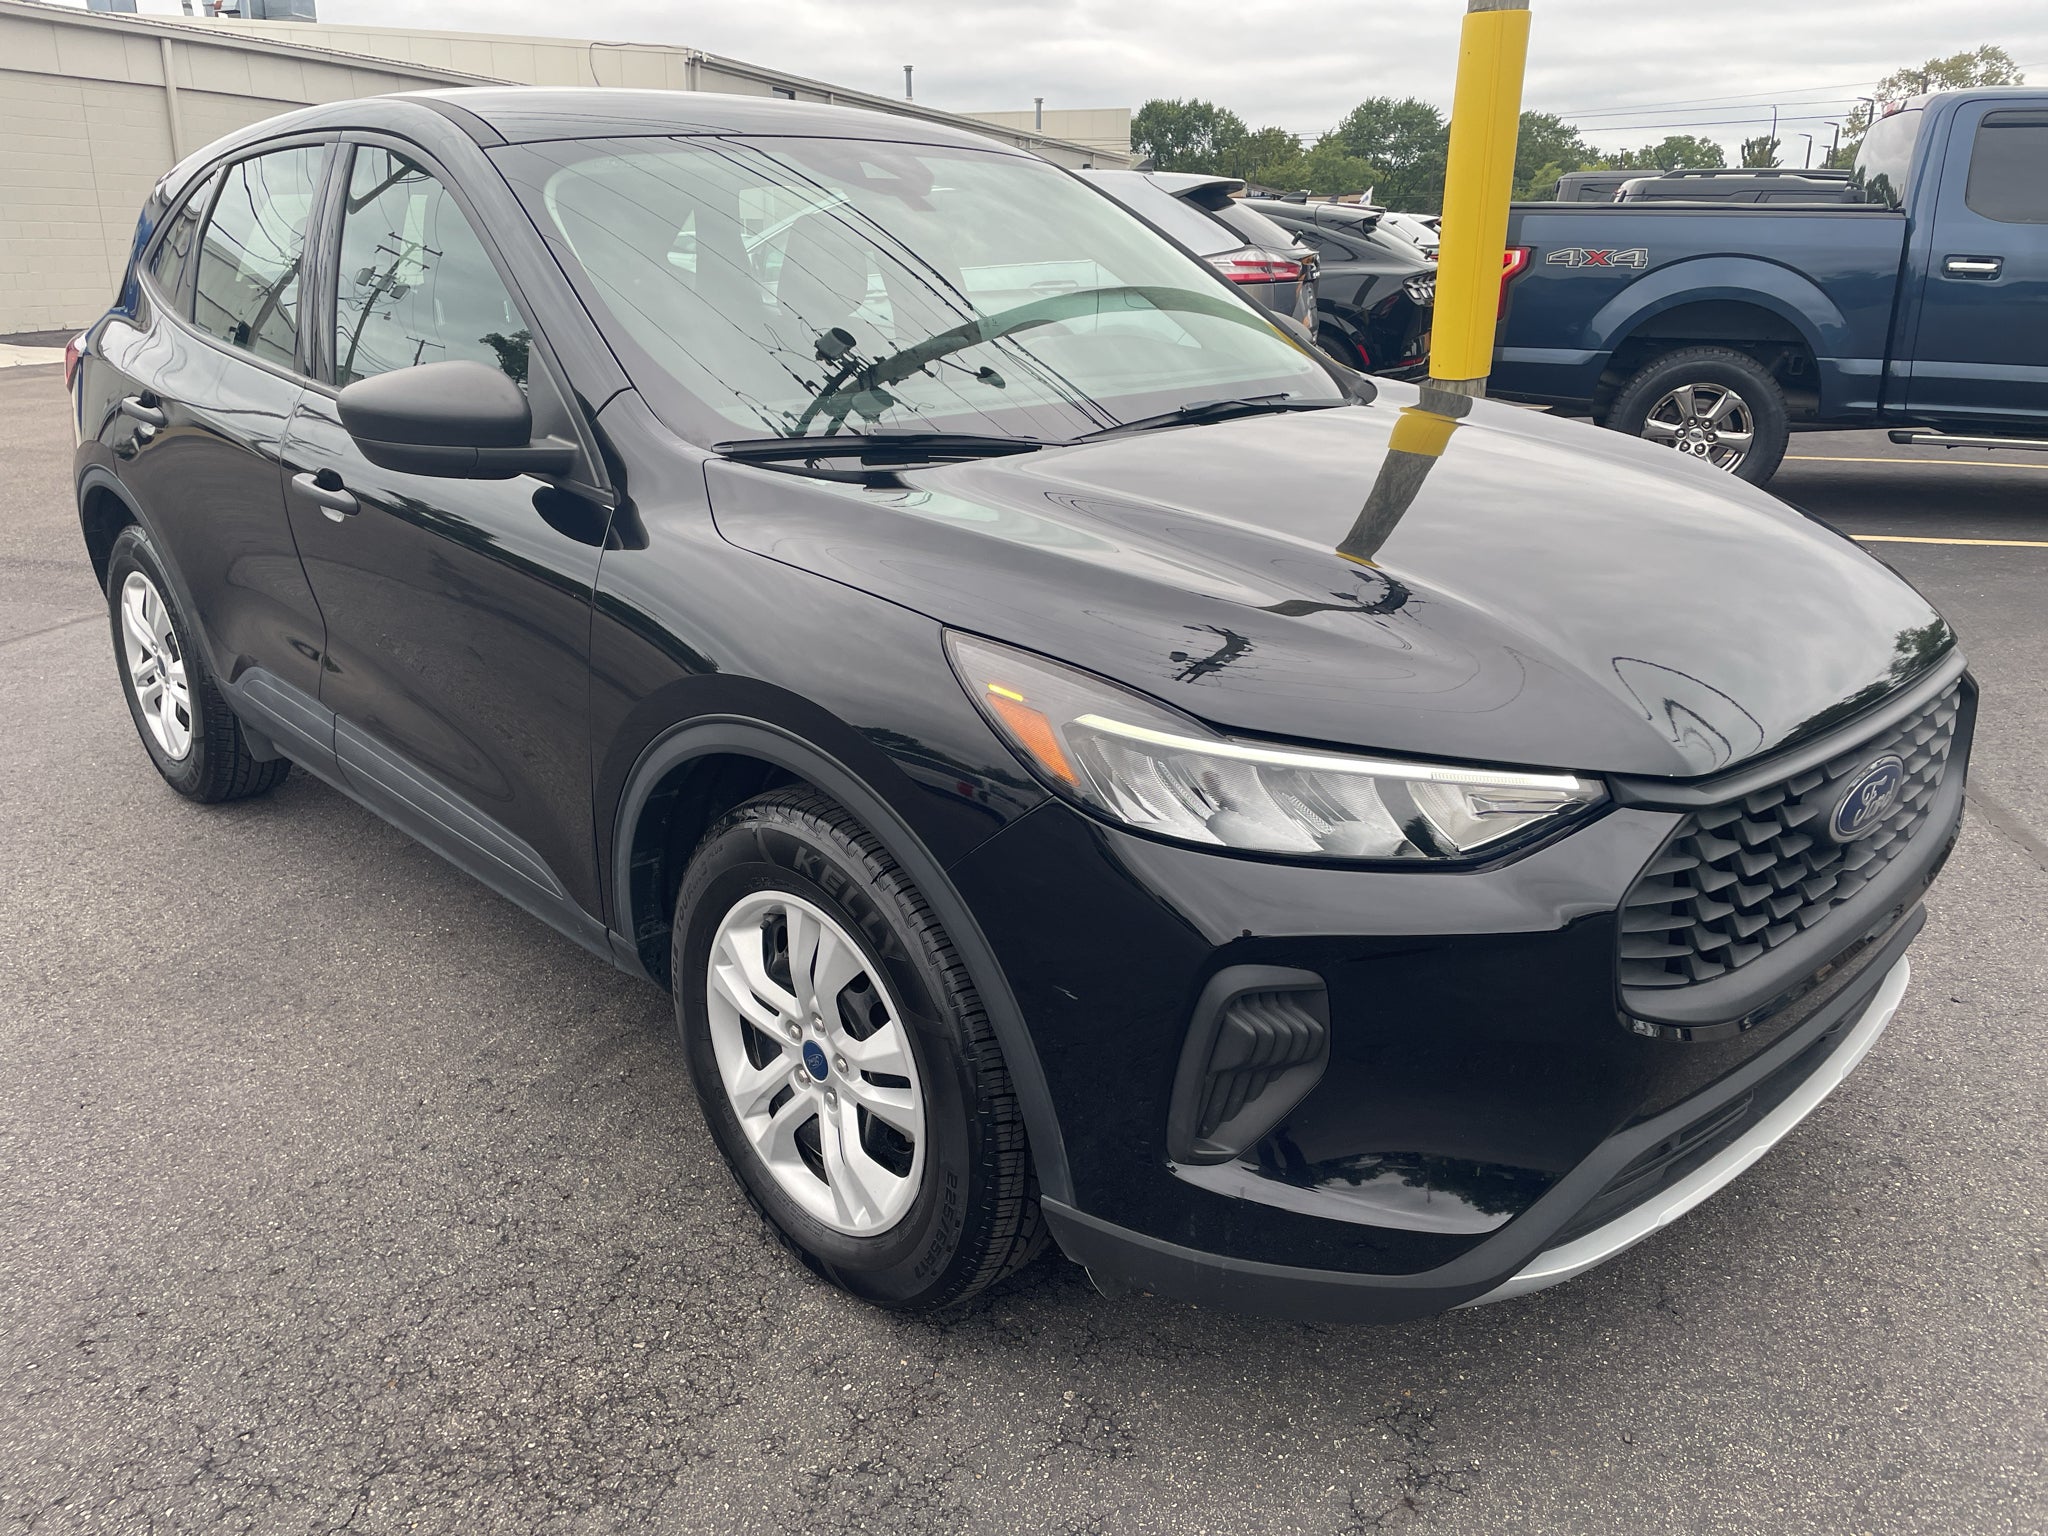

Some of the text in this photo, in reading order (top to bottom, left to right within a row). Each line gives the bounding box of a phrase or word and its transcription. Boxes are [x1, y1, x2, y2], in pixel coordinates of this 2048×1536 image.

[1852, 774, 1896, 827] Ford
[676, 861, 708, 932] TOURING
[793, 845, 908, 962] KELLY
[914, 1169, 959, 1280] 225/65R17
